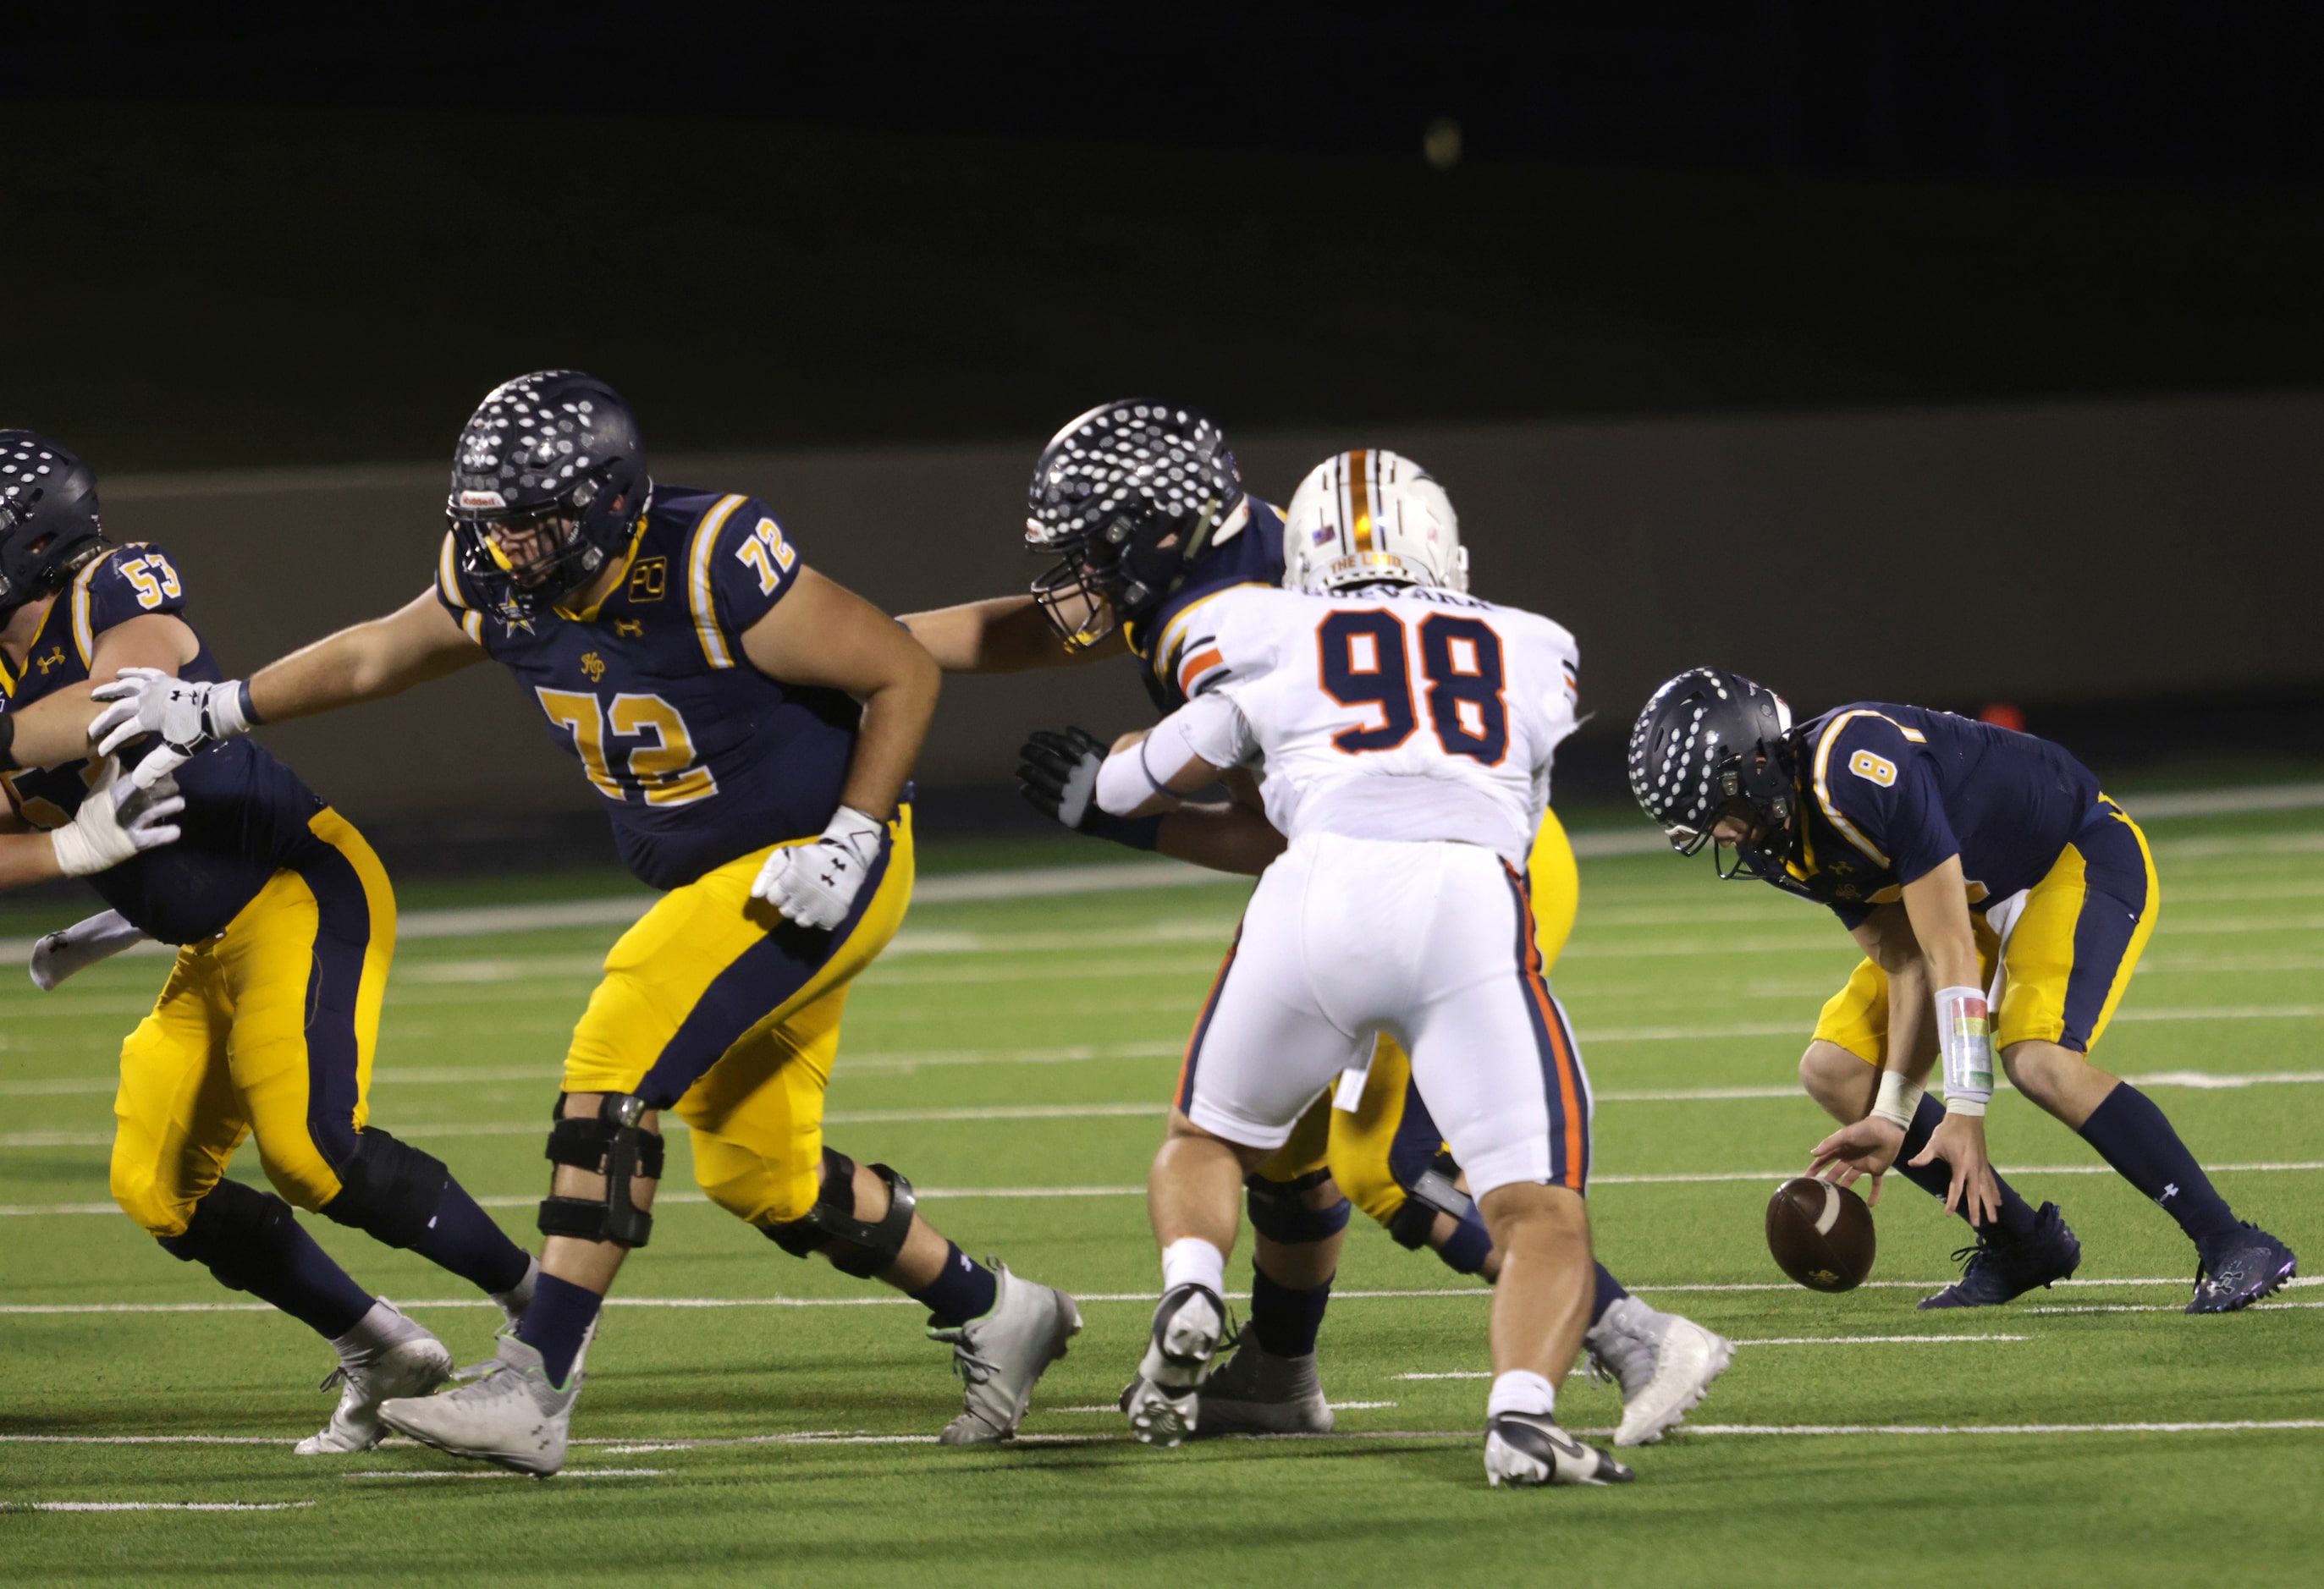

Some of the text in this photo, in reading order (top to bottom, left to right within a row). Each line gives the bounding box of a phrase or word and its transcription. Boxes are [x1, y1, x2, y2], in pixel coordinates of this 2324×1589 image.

[118, 553, 181, 610] 53
[735, 514, 796, 597] 72
[1315, 607, 1510, 768] 98
[535, 685, 719, 807] 72
[1848, 749, 1898, 788] 8
